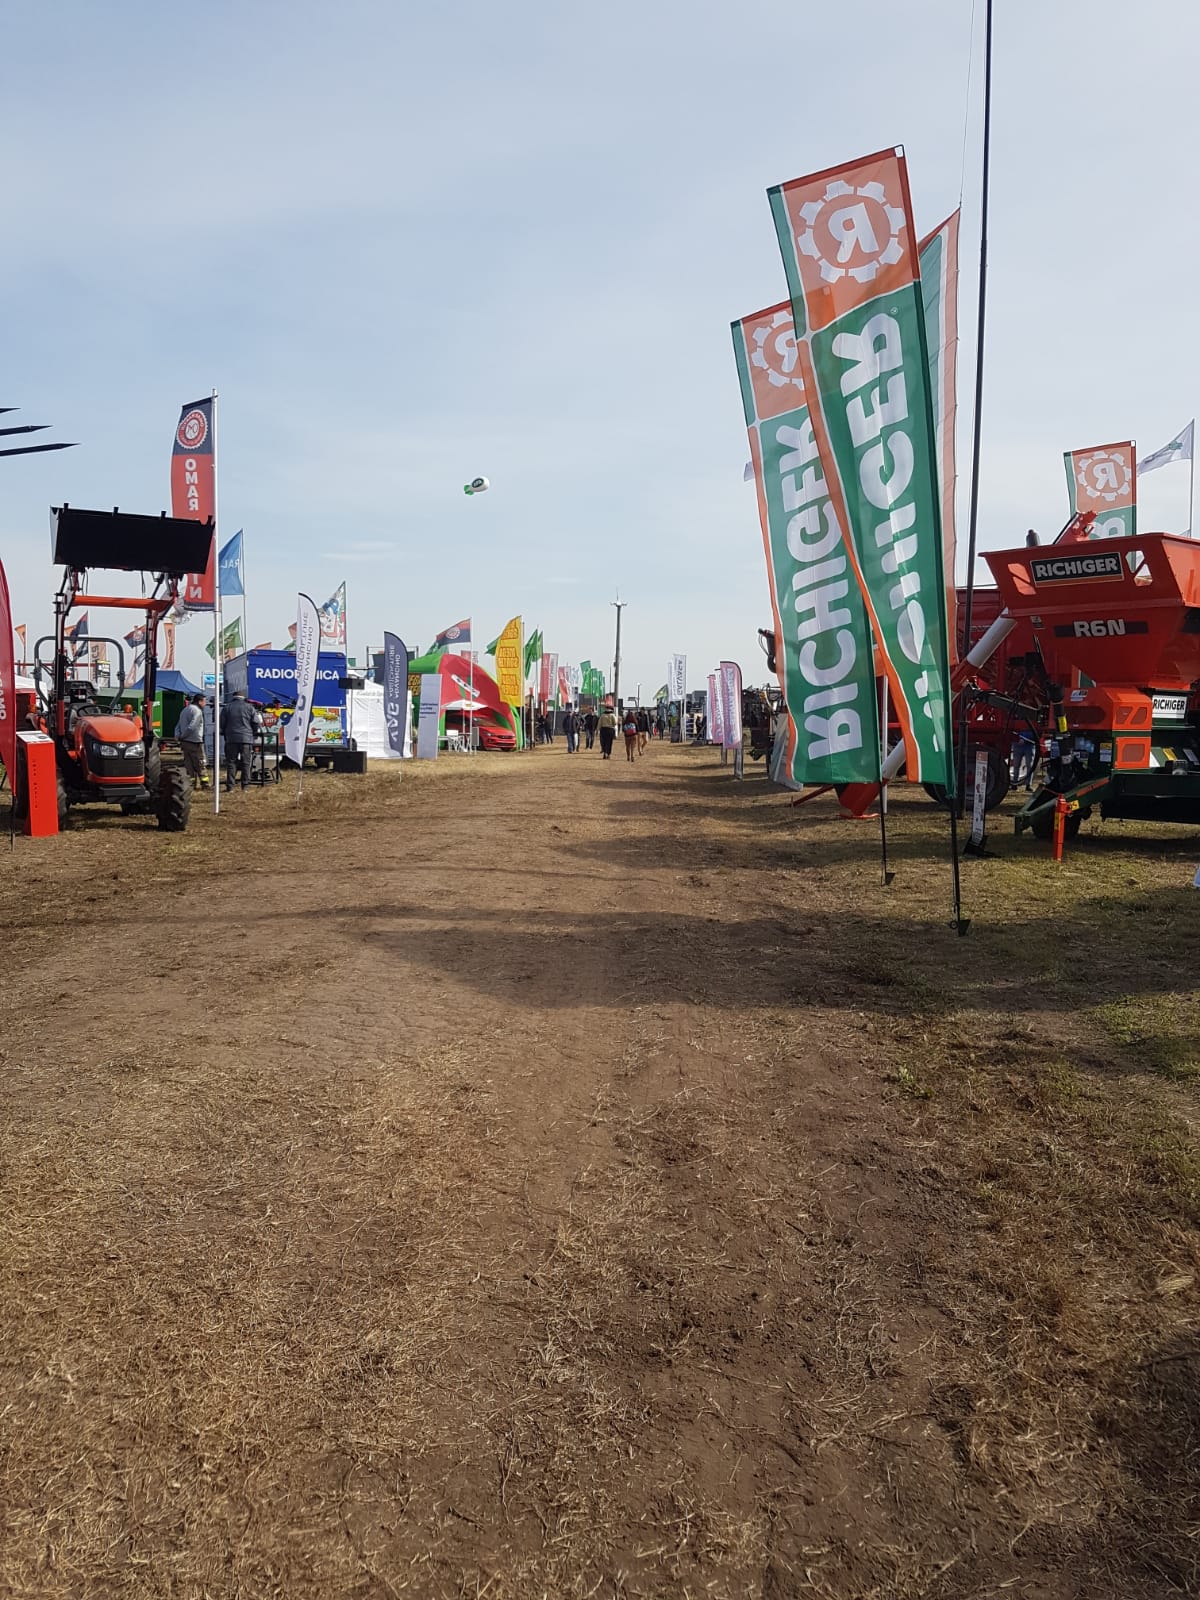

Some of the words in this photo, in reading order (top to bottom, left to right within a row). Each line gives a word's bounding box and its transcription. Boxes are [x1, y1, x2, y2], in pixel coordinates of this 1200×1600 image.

[1035, 557, 1118, 577] RICHIGER
[1073, 618, 1126, 637] R6N
[1152, 698, 1186, 711] RICHIGER
